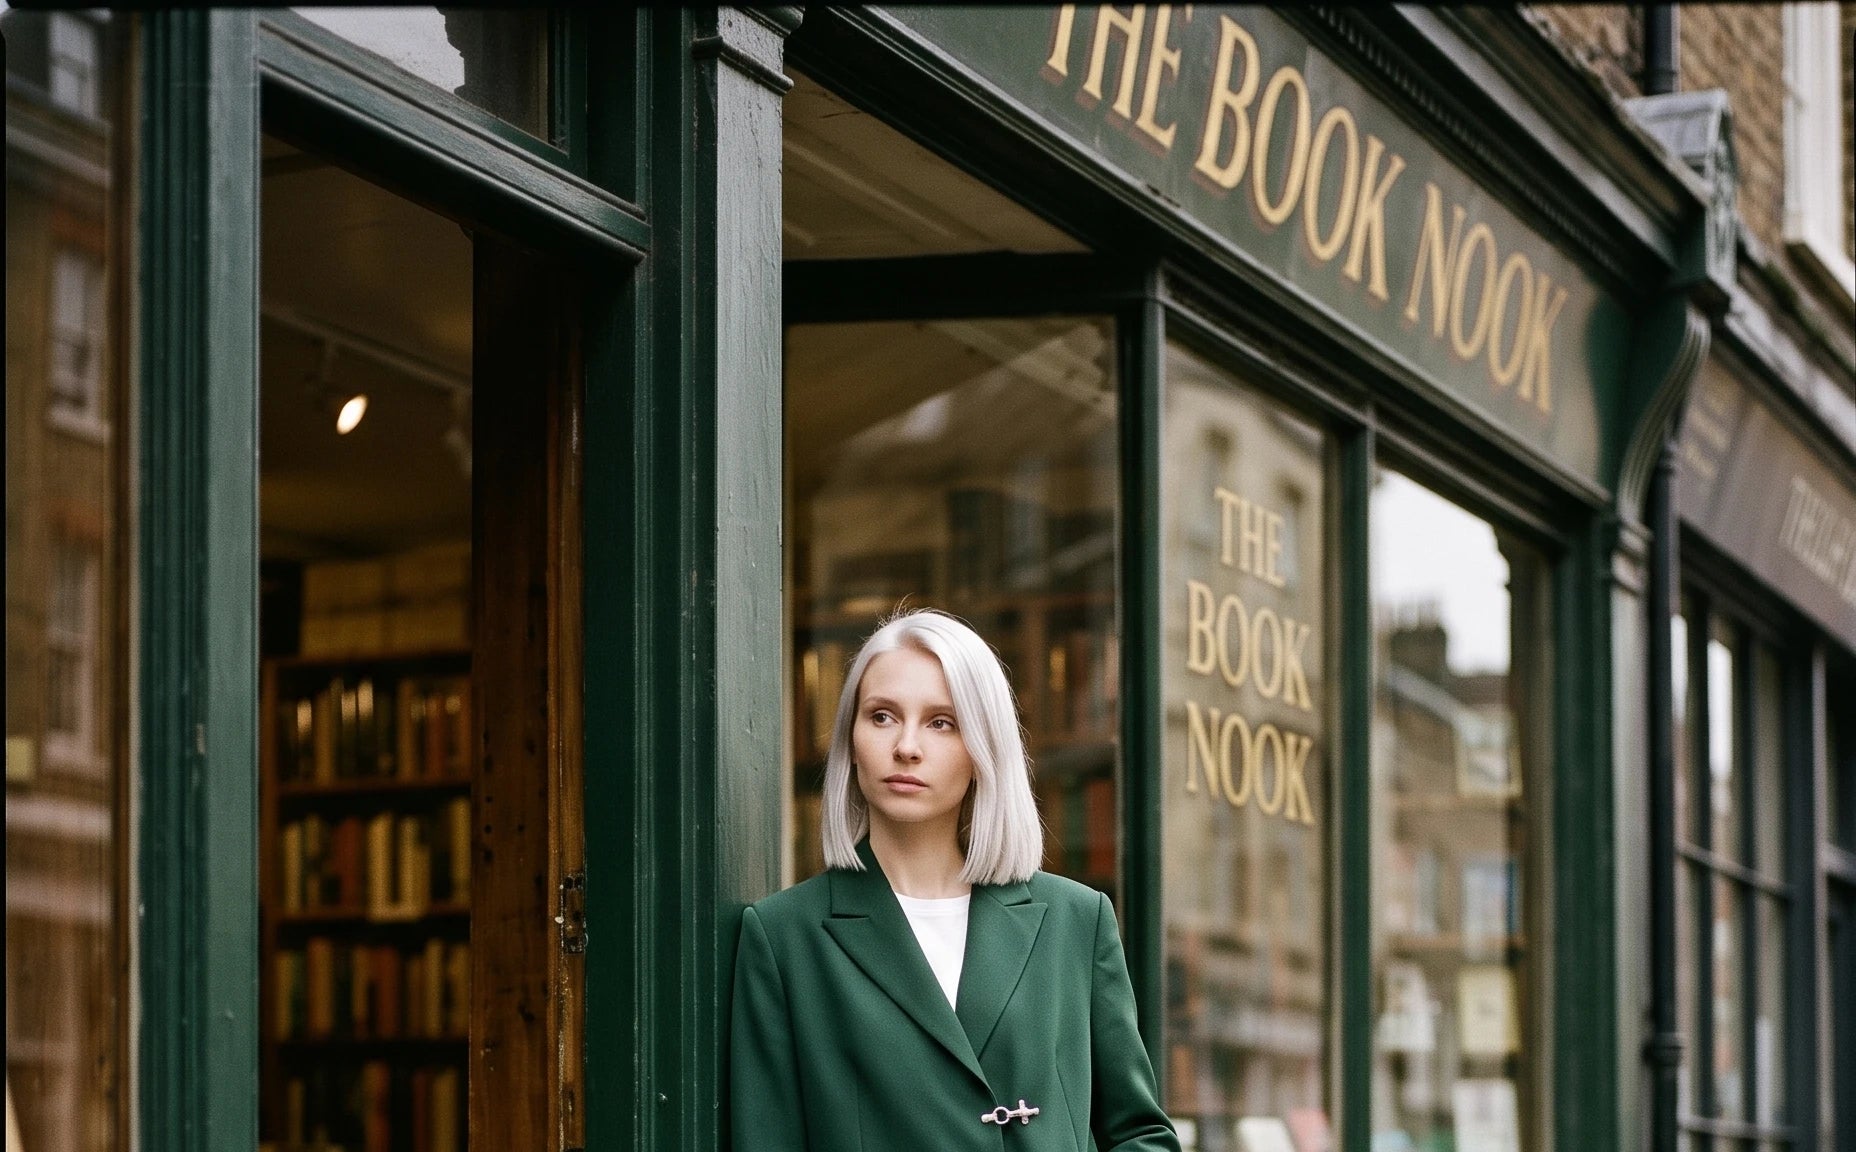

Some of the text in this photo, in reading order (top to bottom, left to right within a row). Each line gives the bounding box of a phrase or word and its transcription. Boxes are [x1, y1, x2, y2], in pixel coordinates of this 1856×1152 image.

[1195, 14, 1405, 301] BOOK
[1404, 182, 1567, 414] NOOK
[1214, 487, 1285, 587] THE
[1187, 580, 1311, 710] BOOK
[1186, 701, 1314, 825] NOOK
